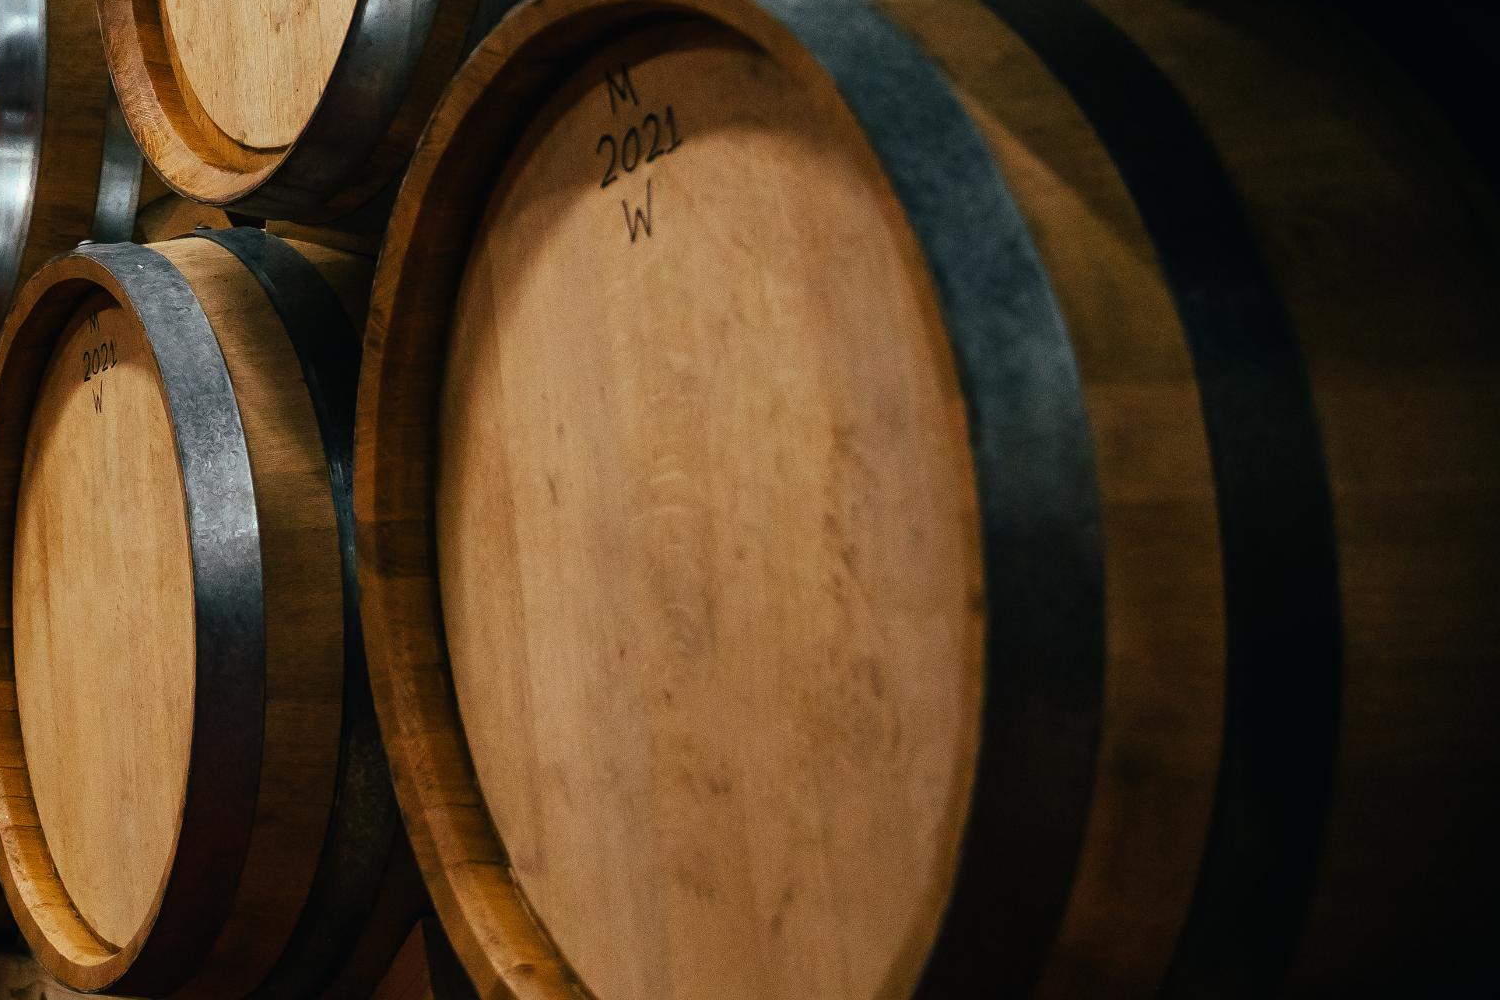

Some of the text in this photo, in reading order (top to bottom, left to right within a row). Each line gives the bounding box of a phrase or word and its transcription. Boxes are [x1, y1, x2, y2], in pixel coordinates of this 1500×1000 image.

[605, 64, 639, 114] M
[596, 104, 683, 188] 2021
[622, 176, 653, 243] W
[83, 339, 118, 382] 2021
[91, 379, 103, 414] W
